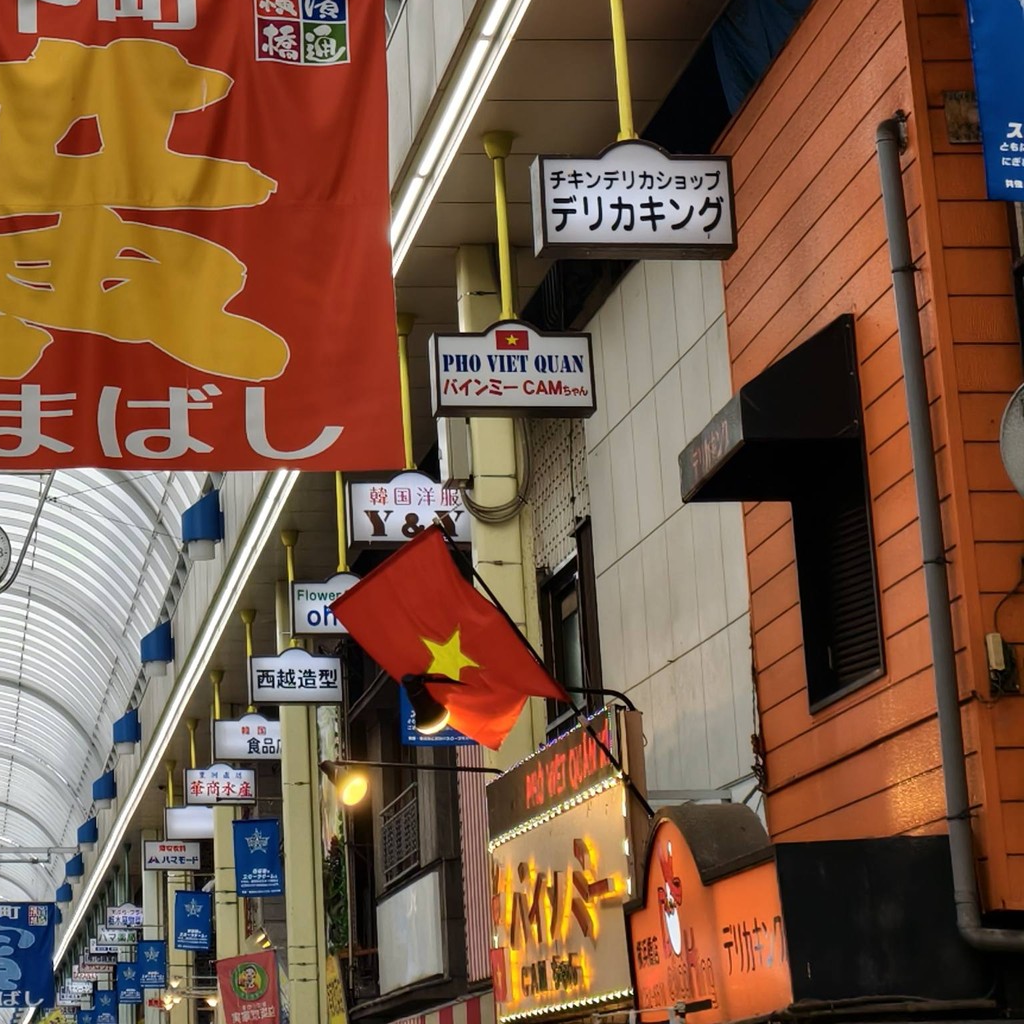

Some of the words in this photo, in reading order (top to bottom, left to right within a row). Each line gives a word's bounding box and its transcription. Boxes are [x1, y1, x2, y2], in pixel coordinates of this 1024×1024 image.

[550, 170, 721, 191] チキンデリカショップ
[551, 195, 724, 232] デリカキング
[442, 354, 481, 373] PHO
[487, 354, 528, 373] VIET
[534, 354, 584, 374] QUAN
[443, 379, 518, 396] バインミー
[369, 487, 460, 507] 韓国洋服
[256, 668, 338, 689] 西越造型
